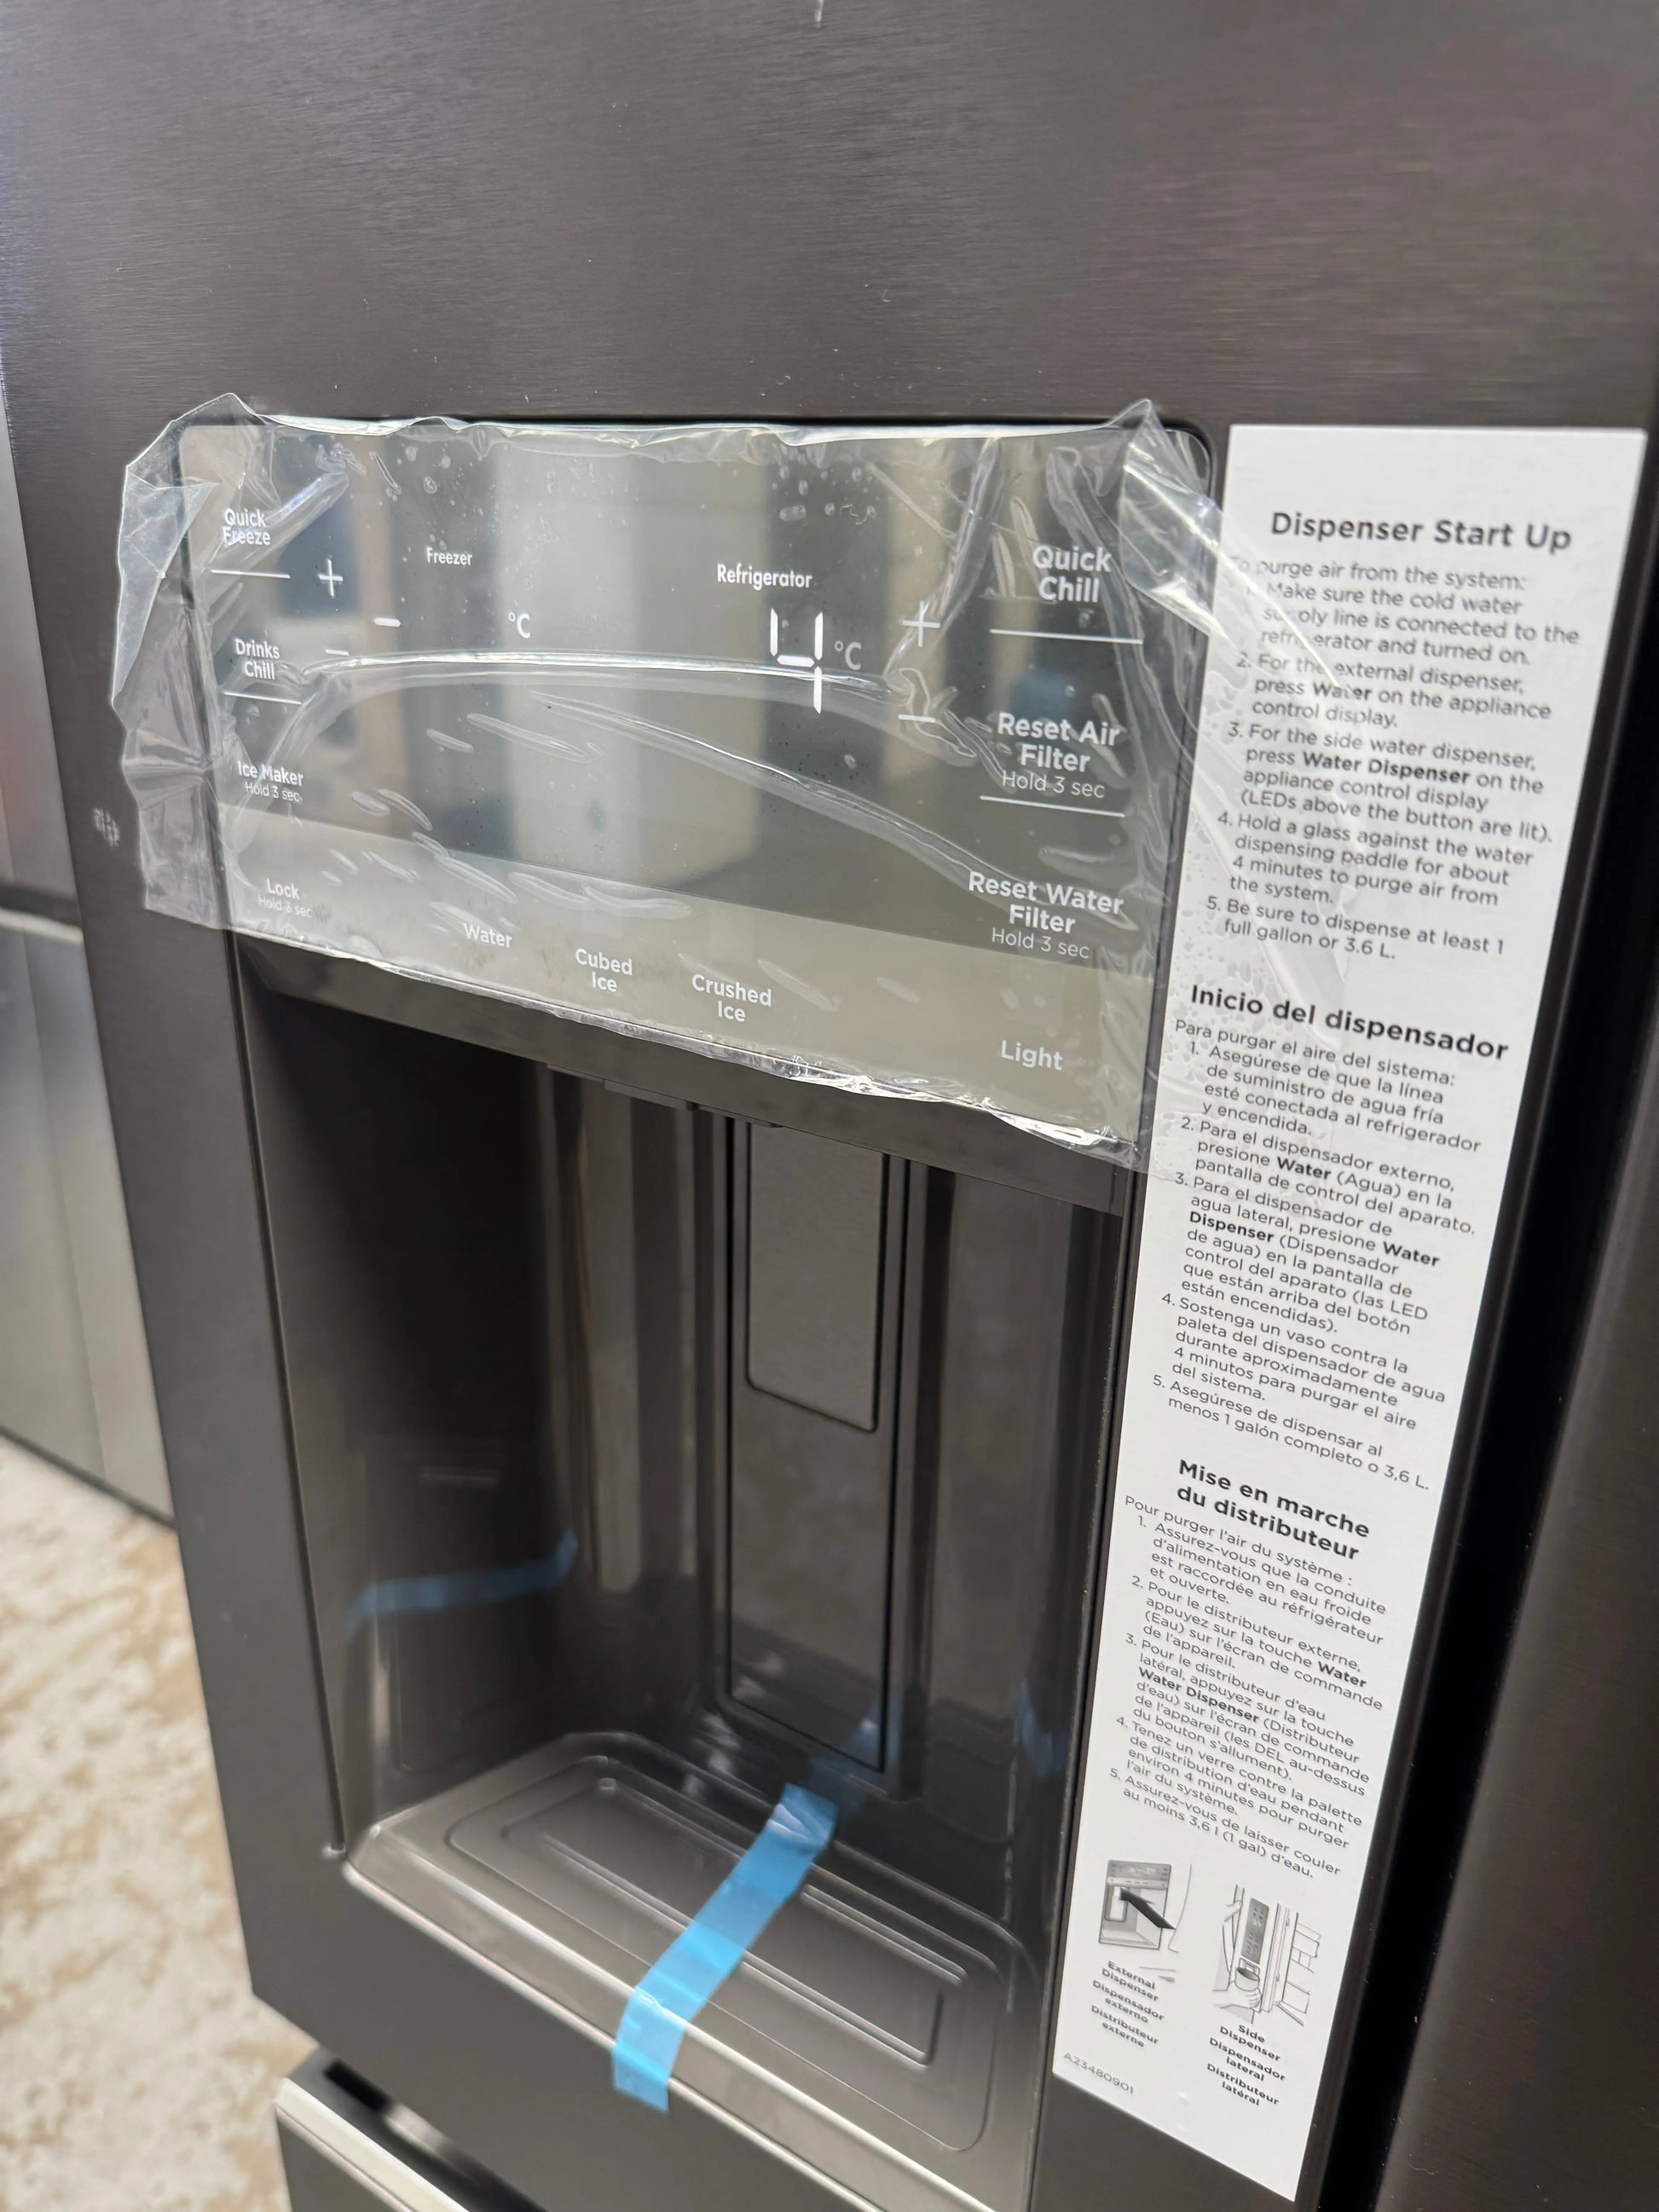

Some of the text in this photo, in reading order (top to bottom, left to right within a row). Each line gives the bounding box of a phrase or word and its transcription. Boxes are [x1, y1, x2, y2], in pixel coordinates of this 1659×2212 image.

[224, 507, 267, 527] Quick
[1270, 511, 1572, 556] Dispenser Start Up
[223, 526, 271, 546] Freeze
[426, 546, 473, 566] Freezer
[1032, 545, 1112, 572] Quick
[717, 563, 813, 591] Refrigerator
[1039, 575, 1100, 603] Chill
[235, 638, 280, 659] Drinks
[770, 607, 823, 714] 4
[245, 661, 275, 679] Chill
[997, 712, 1120, 746] Reset Air
[1227, 720, 1535, 771] 3. For the side water dispenser,
[239, 760, 303, 786] Ice Maker
[1020, 742, 1090, 772] Filter
[1246, 748, 1544, 794] press Water Dispenser on the
[246, 781, 301, 802] Hold 3 sec
[1003, 770, 1105, 798] Hold 3 sec
[1243, 770, 1489, 814] appliance control display
[1240, 788, 1552, 844] (LEDs above the button are lit).
[1217, 811, 1534, 866] 4. Hold a glass against the water
[1234, 834, 1510, 886] dispensing paddle for about
[258, 894, 282, 910] Hold
[267, 878, 300, 900] Lock
[968, 870, 1124, 915] Reset Water
[463, 922, 512, 949] Water
[1009, 904, 1075, 933] Filter
[1206, 895, 1504, 956] 5. Be sure to dispense at least 1
[991, 927, 1090, 959] Hold 3 sec
[1224, 917, 1396, 960] full gallon or 3.6 L.
[575, 948, 633, 976] Cubed
[592, 972, 618, 992] Ice
[691, 973, 772, 1007] Crushed
[717, 1000, 746, 1022] Ice
[1190, 984, 1510, 1061] Inicio del dispensador
[1002, 1039, 1063, 1071] Light
[1175, 1018, 1455, 1087] Para purgar el aire del sistema:
[1197, 1141, 1452, 1210] presione Water (Agua) en la
[1195, 1158, 1475, 1235] pantalla de control del aparato.
[1181, 1280, 1338, 1333] están encendidas).
[1168, 1397, 1429, 1491] menos 1 galón completo o 3,6 L.
[1178, 1458, 1370, 1539] Mise en marche
[1176, 1486, 1360, 1561] du distributeur
[1151, 1553, 1384, 1644] est raccordée au réfrigérateur
[1144, 1610, 1383, 1711] (Eau) sur l'écran de commande
[1133, 1707, 1292, 1781] du bouton s'allument).
[1123, 1788, 1140, 1802] au
[1143, 1797, 1185, 1822] moins
[1223, 1830, 1234, 1843] (1
[1238, 1839, 1267, 1857] gal)
[1270, 1853, 1314, 1879] d'eau.
[1101, 1967, 1159, 2002] Dispenser
[1107, 1960, 1156, 1990] External
[1092, 1979, 1165, 2021] Dispensador
[1104, 1997, 1149, 2024] externo
[1090, 2004, 1159, 2044] Distributeur
[1101, 2022, 1145, 2048] externe
[1237, 2024, 1266, 2044] Side
[1209, 2036, 1286, 2082] Dispensador
[1219, 2025, 1281, 2062] Dispenser
[1063, 2053, 1134, 2094] A23480901
[1206, 2062, 1280, 2105] Distributeur
[1226, 2055, 1265, 2082] lateral
[1222, 2080, 1260, 2107] latéral
